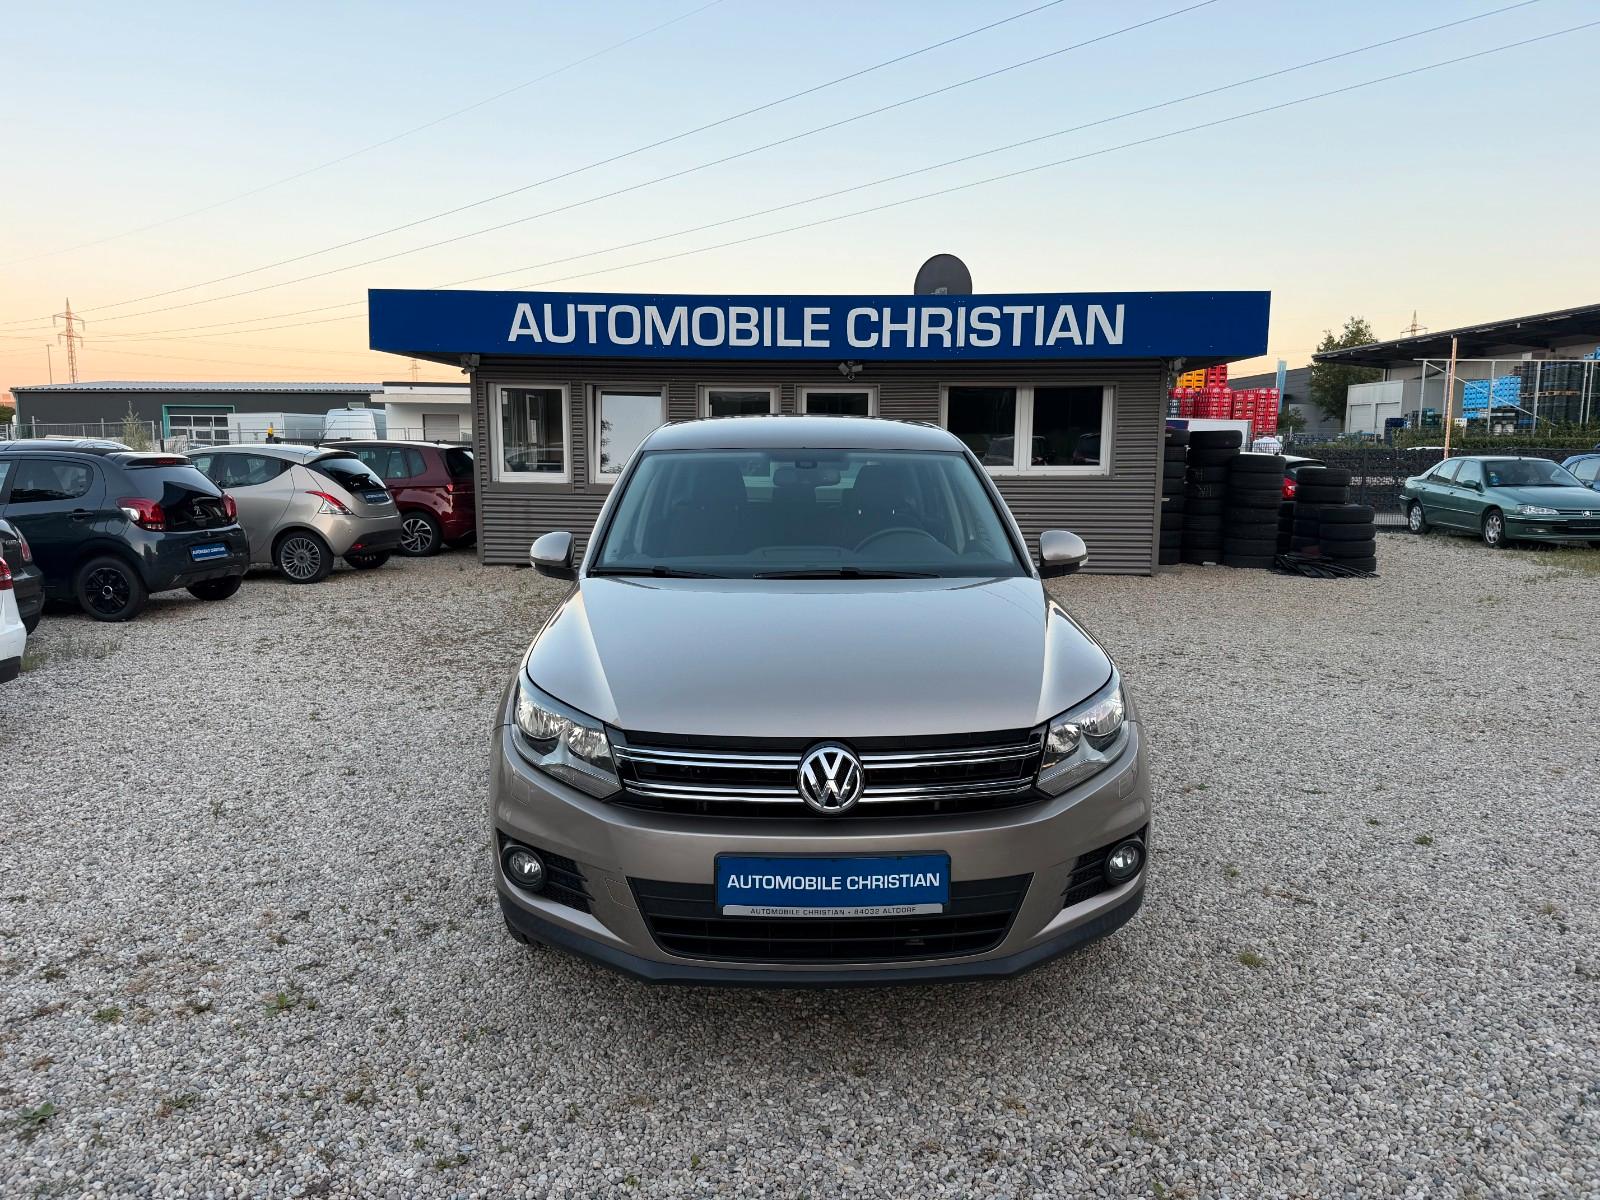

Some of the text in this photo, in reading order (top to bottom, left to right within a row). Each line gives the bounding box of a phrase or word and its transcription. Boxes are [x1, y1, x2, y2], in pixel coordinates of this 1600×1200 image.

[507, 302, 1125, 348] AUTOMOBILE CHRISTIAN
[727, 873, 940, 890] AUTOMOBILE CHRISTIAN
[750, 907, 800, 916] AUTOMOBILE
[802, 908, 845, 916] CHRISTIAN
[882, 906, 917, 915] ALTDORF
